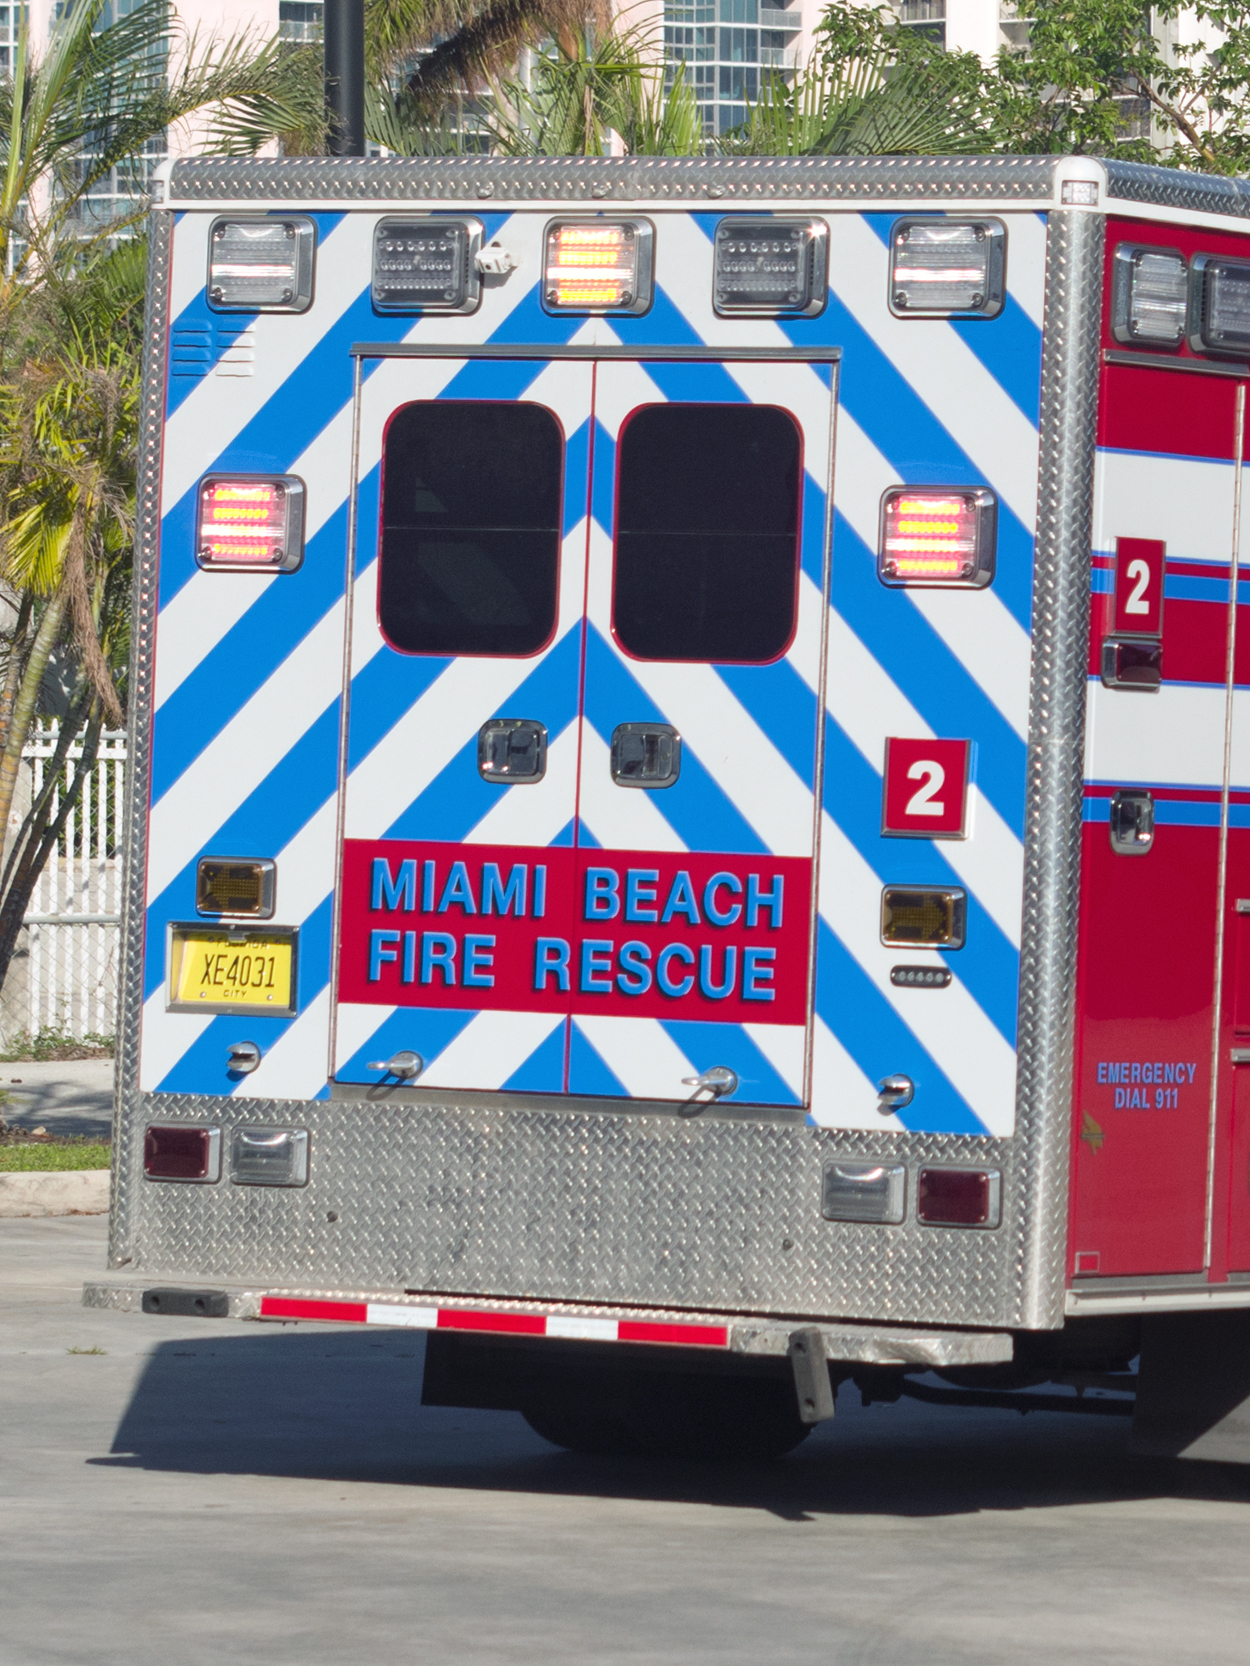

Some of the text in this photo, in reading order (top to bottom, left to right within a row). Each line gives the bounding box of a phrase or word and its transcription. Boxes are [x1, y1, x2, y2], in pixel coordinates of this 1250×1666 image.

[1124, 558, 1151, 615] 2
[904, 759, 946, 816] 2
[370, 857, 785, 929] MIAMI BEACH
[200, 953, 276, 988] XE4031
[368, 928, 777, 1002] FIRE RESCUE
[223, 989, 247, 998] CITY
[1097, 1062, 1197, 1084] EMERGENCY
[1114, 1088, 1179, 1109] DIAL 911
